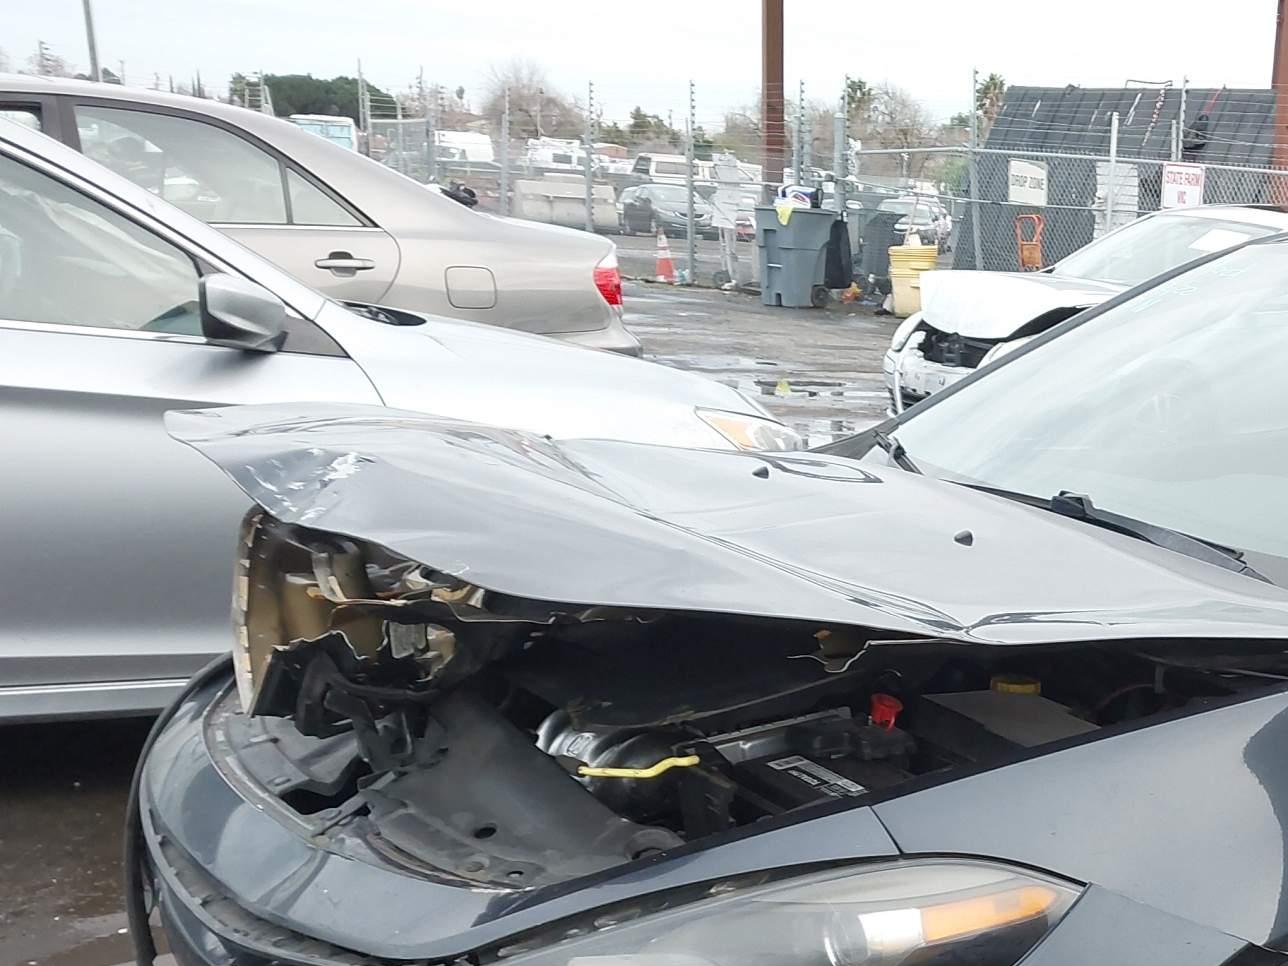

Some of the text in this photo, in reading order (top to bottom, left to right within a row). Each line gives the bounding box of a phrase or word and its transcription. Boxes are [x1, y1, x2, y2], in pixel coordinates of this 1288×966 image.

[1011, 174, 1045, 191] DROP ZONE
[1165, 171, 1201, 187] STATE FARM
